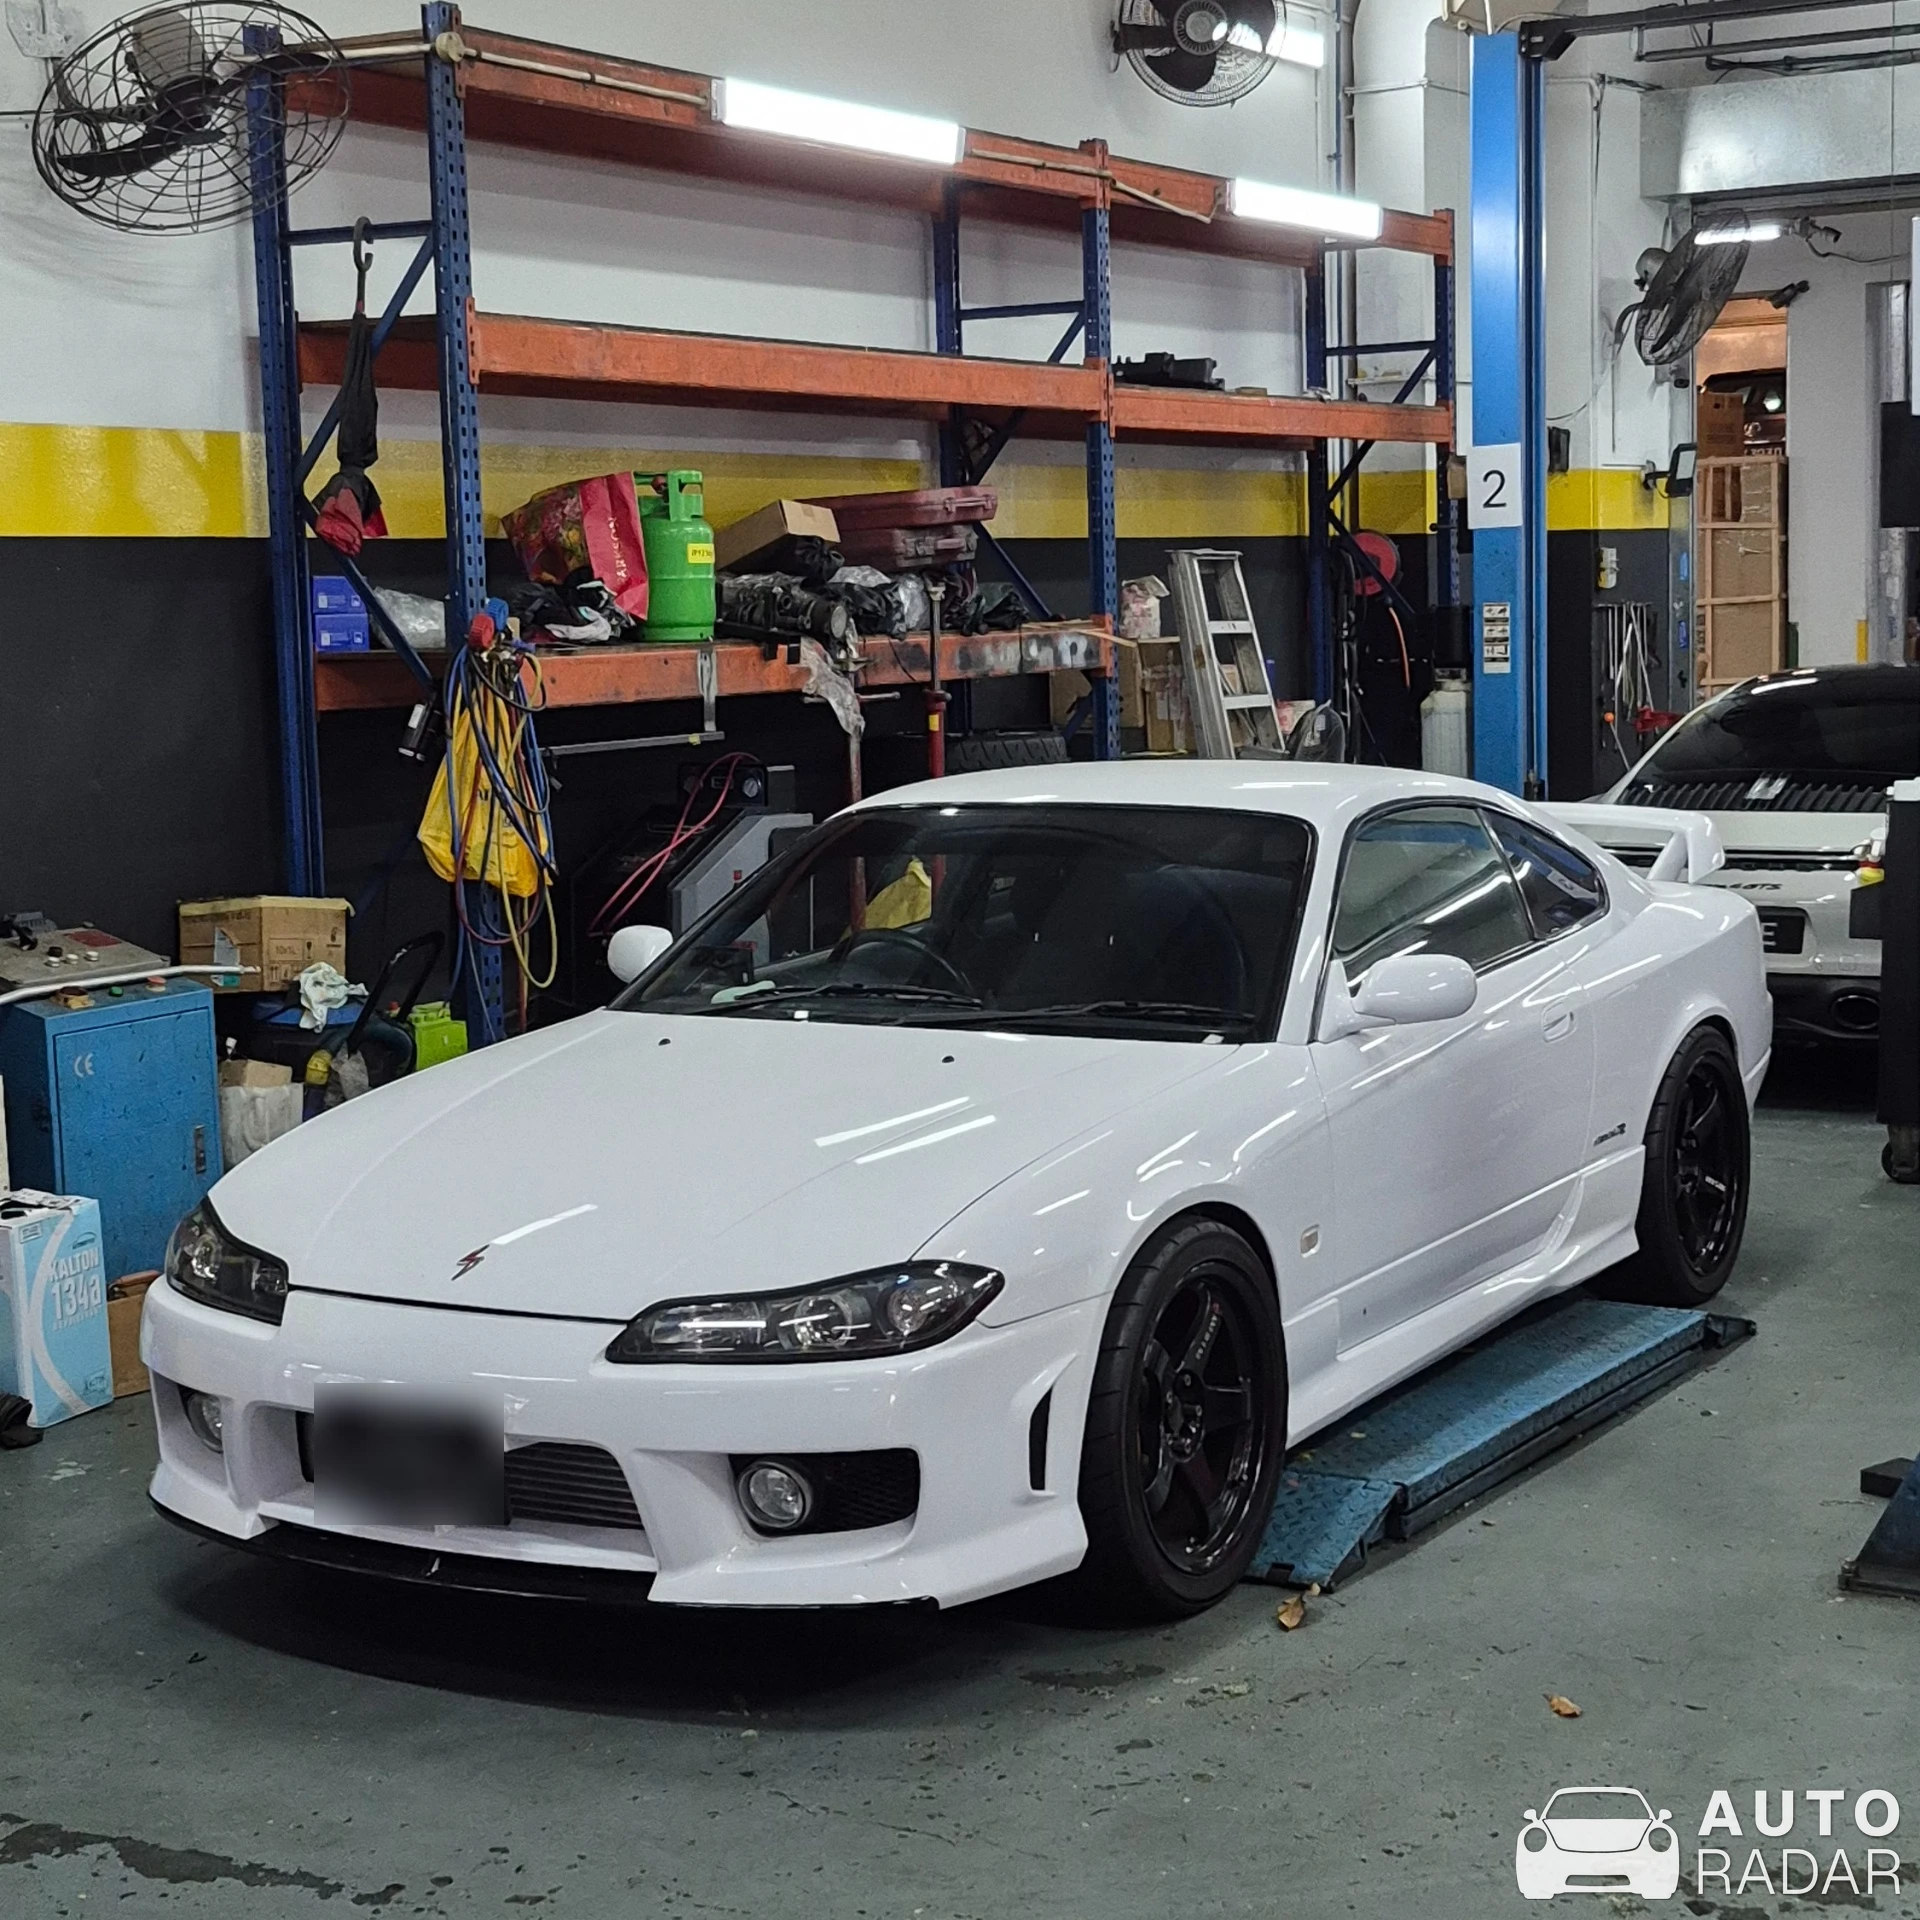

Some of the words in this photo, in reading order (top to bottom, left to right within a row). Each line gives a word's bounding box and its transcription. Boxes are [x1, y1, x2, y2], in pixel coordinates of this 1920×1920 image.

[1482, 469, 1507, 509] 2
[50, 1247, 100, 1283] KALTON
[52, 1273, 102, 1321] 134a
